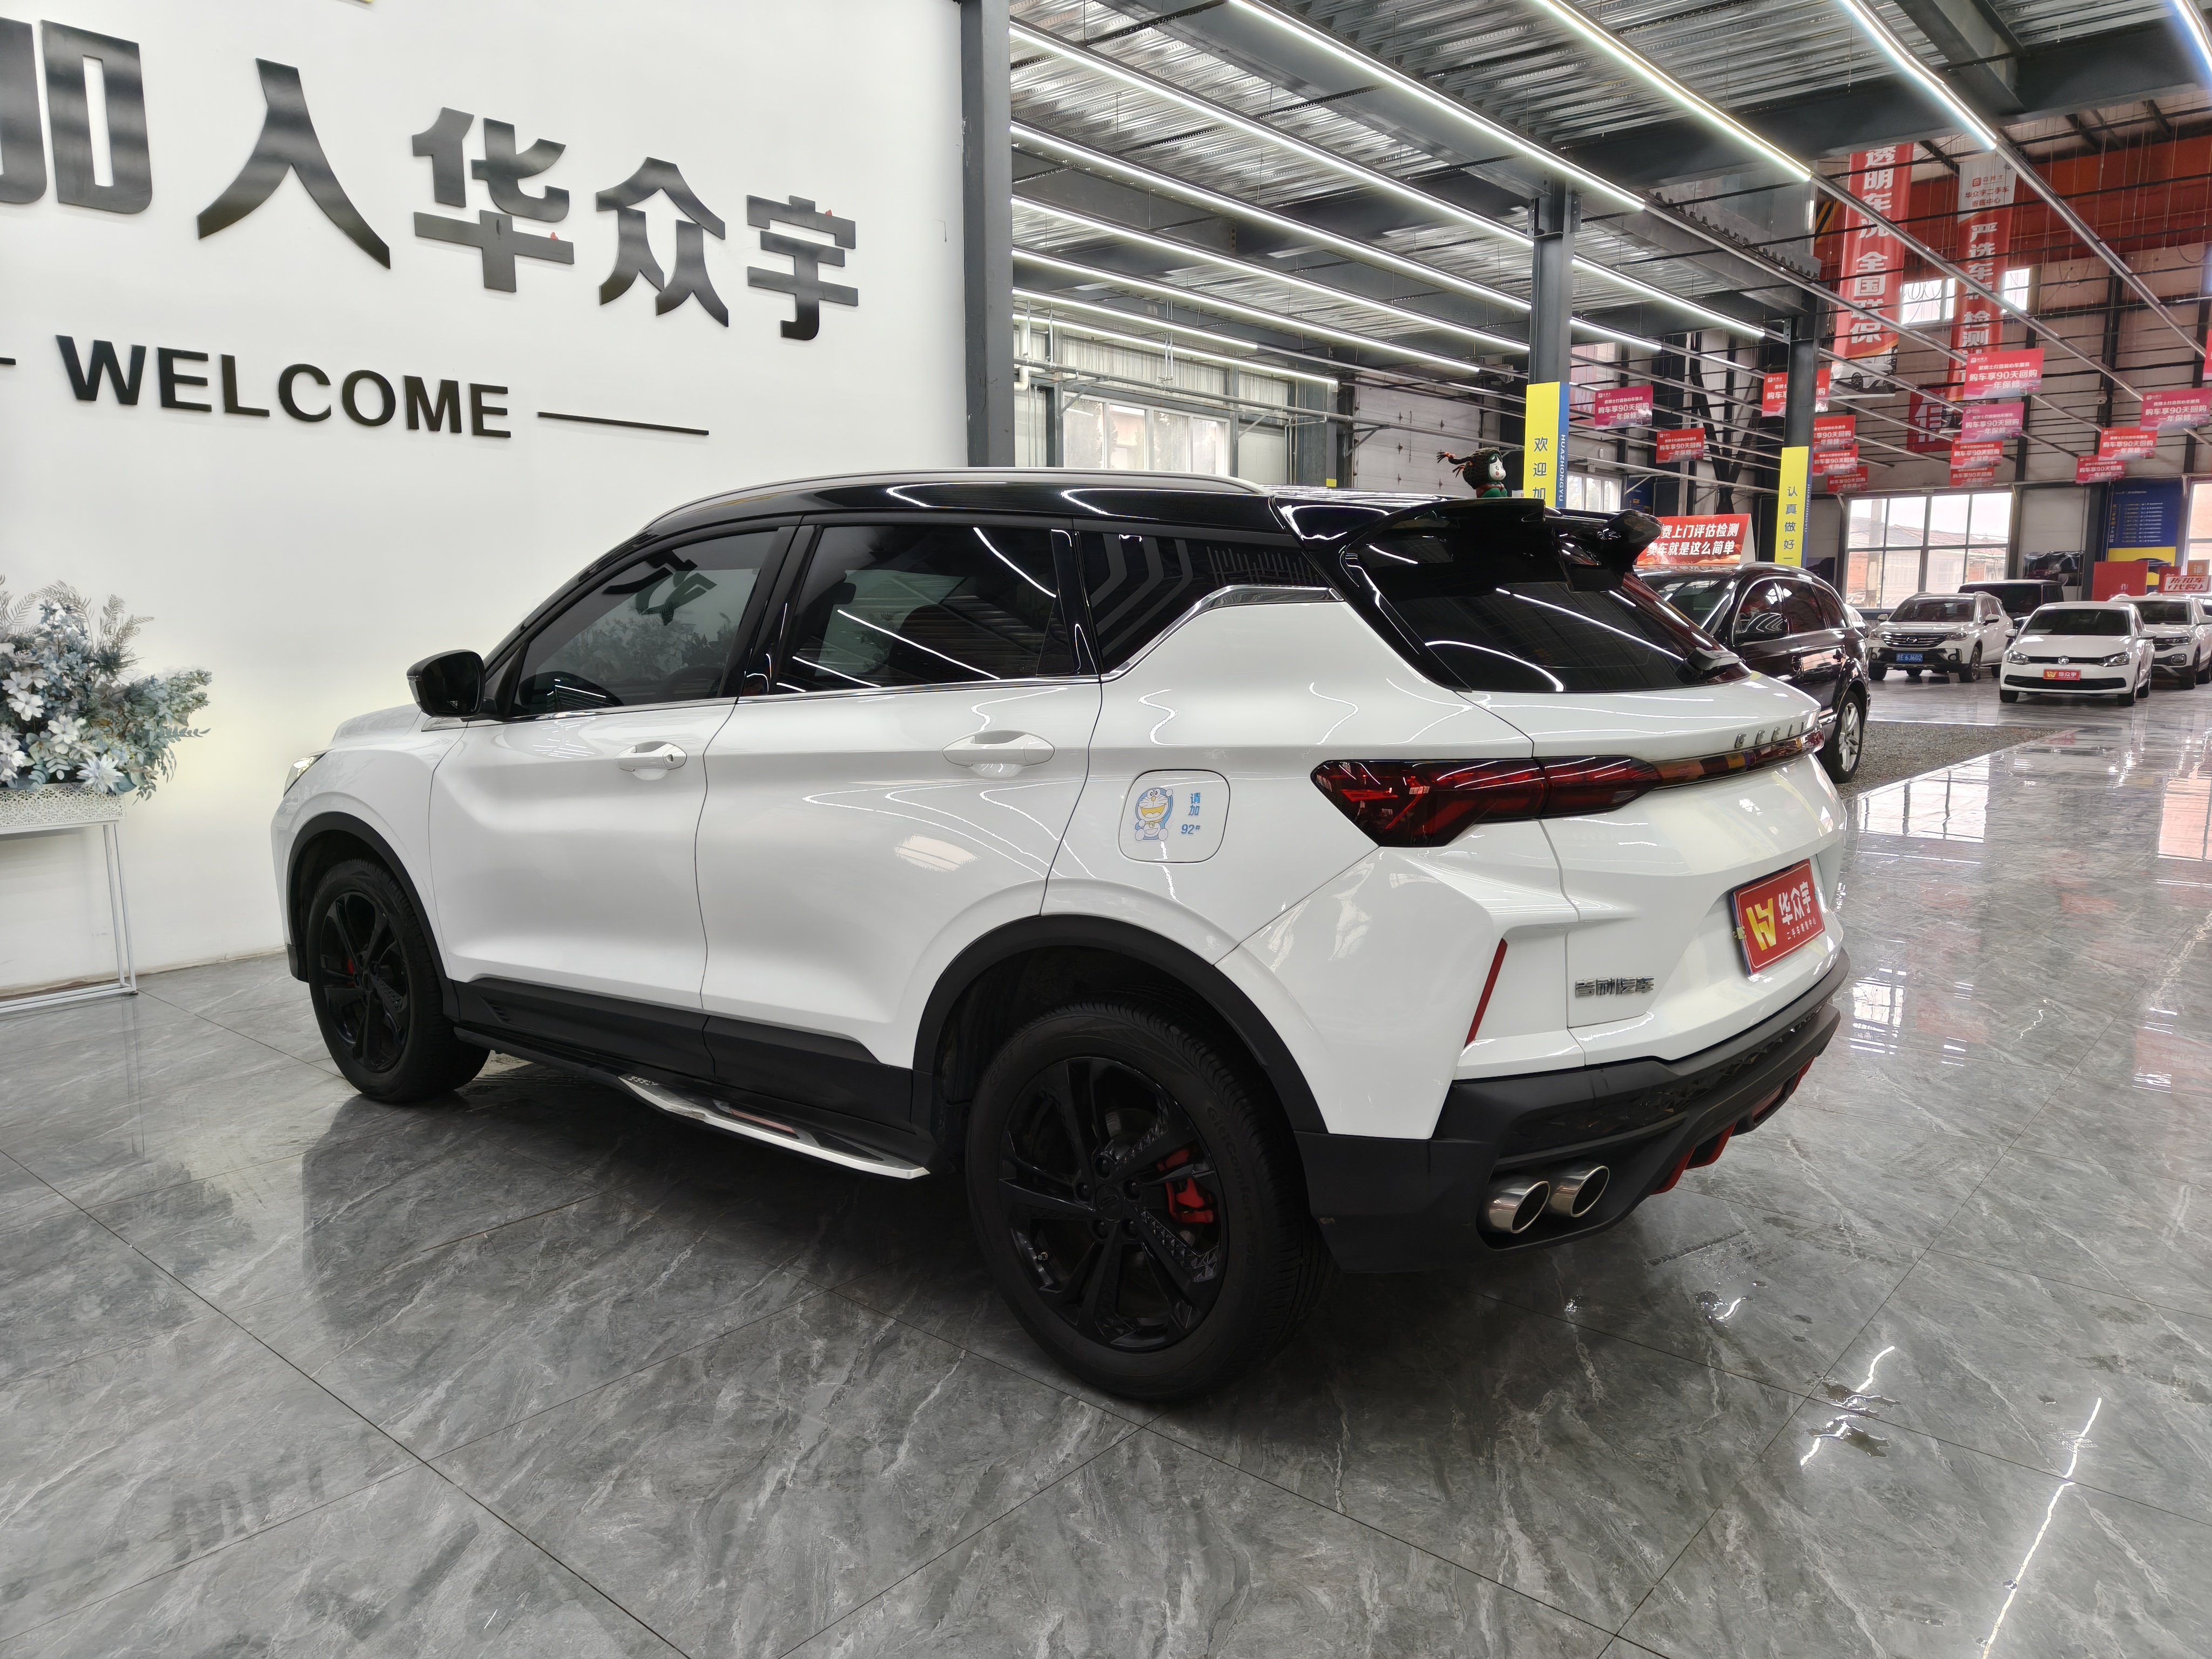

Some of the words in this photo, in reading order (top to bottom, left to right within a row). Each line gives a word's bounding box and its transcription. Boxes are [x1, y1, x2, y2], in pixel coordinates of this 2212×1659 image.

[1969, 369, 2038, 382] 购车享90天回购
[56, 333, 511, 439] WELCOME
[1984, 380, 2021, 389] 一年保修
[1598, 403, 1649, 414] 购车享90天回购
[2145, 405, 2207, 416] 购车享90天回购
[1609, 412, 1637, 420] 一年保修
[1965, 419, 2020, 428] 购车享90天回购
[1660, 442, 1702, 451] 购车享90天回购
[1783, 485, 1798, 559] 认真做好一
[1657, 522, 1740, 539] 费上门评估检测
[1646, 540, 1736, 556] 卖车就是这么简单
[1188, 792, 1201, 816] 请加
[1181, 824, 1201, 835] 92#
[1778, 881, 1811, 926] 华众宇
[1575, 976, 1654, 998] 吉利汽车
